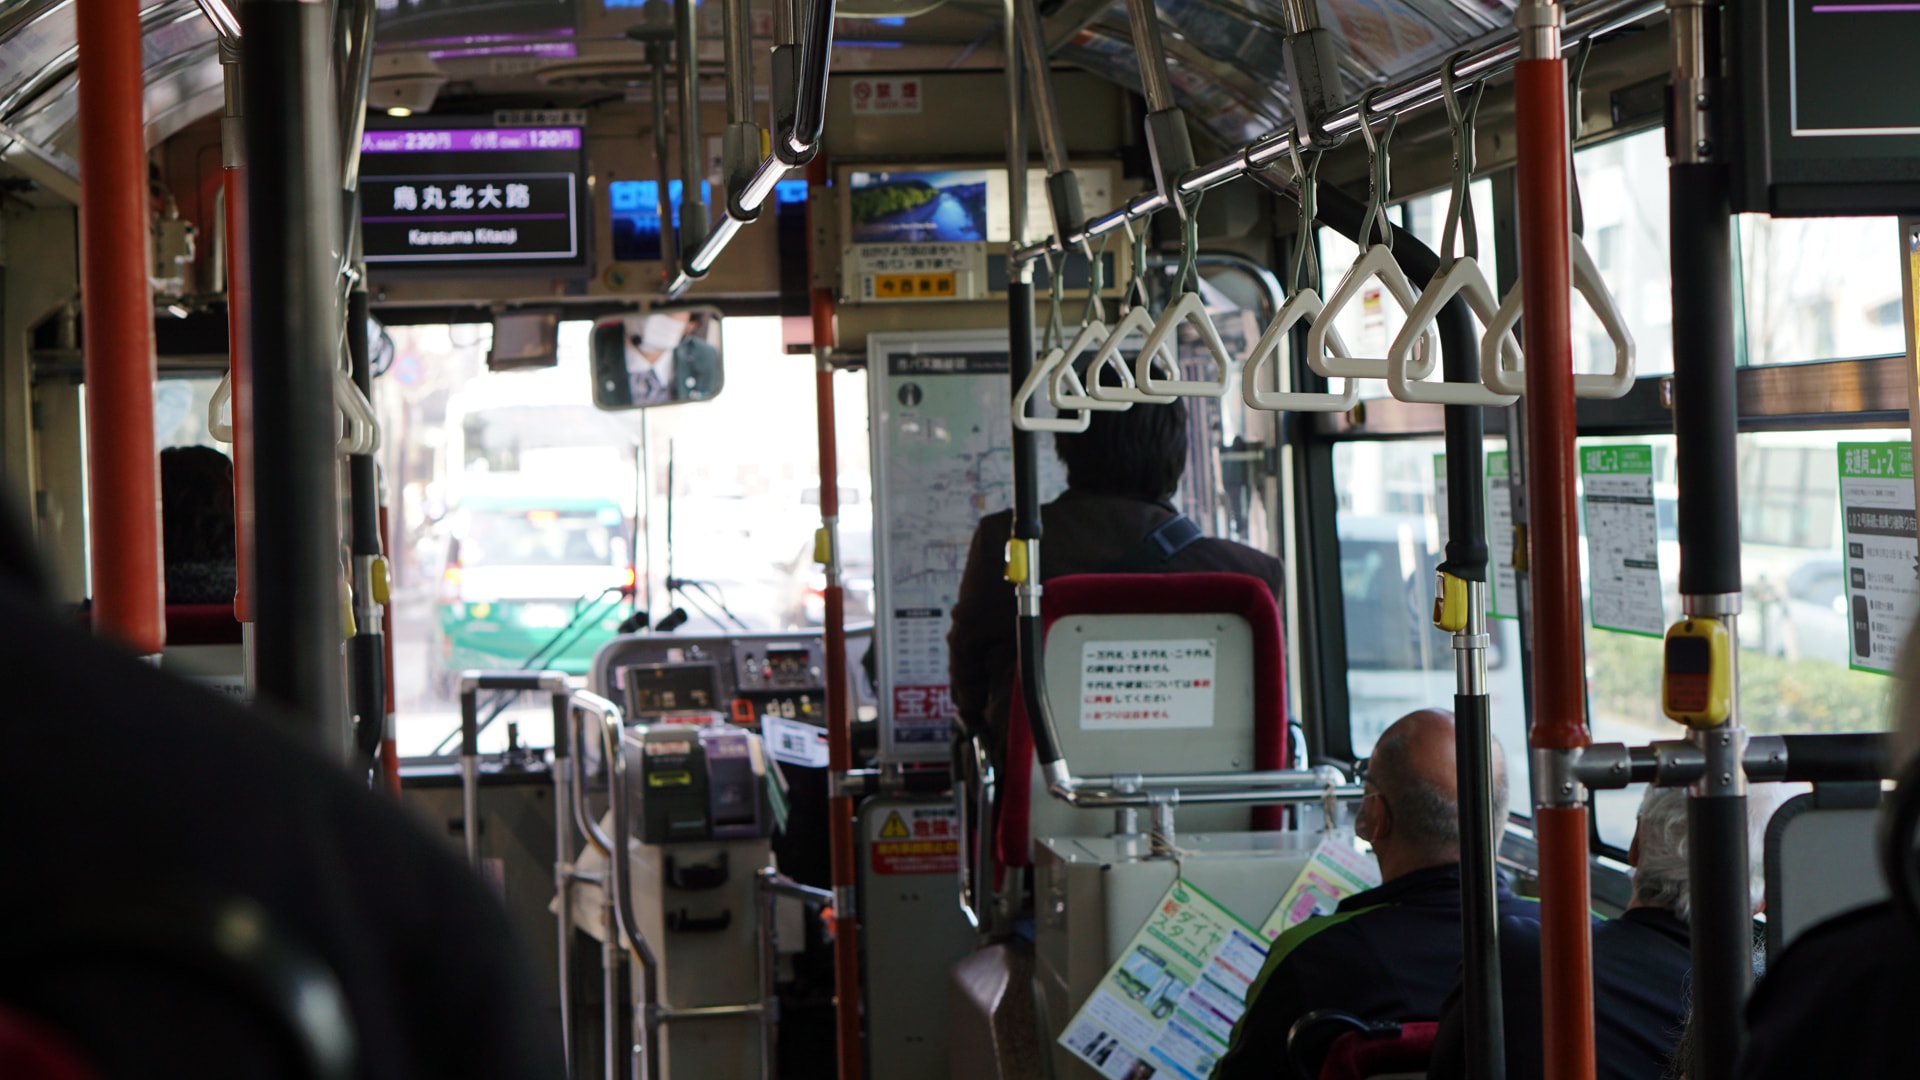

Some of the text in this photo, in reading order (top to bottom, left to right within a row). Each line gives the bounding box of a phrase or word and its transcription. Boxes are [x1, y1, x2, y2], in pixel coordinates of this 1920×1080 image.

[404, 132, 452, 150] 230円
[529, 129, 574, 148] 120円
[408, 229, 474, 246] Karasuma
